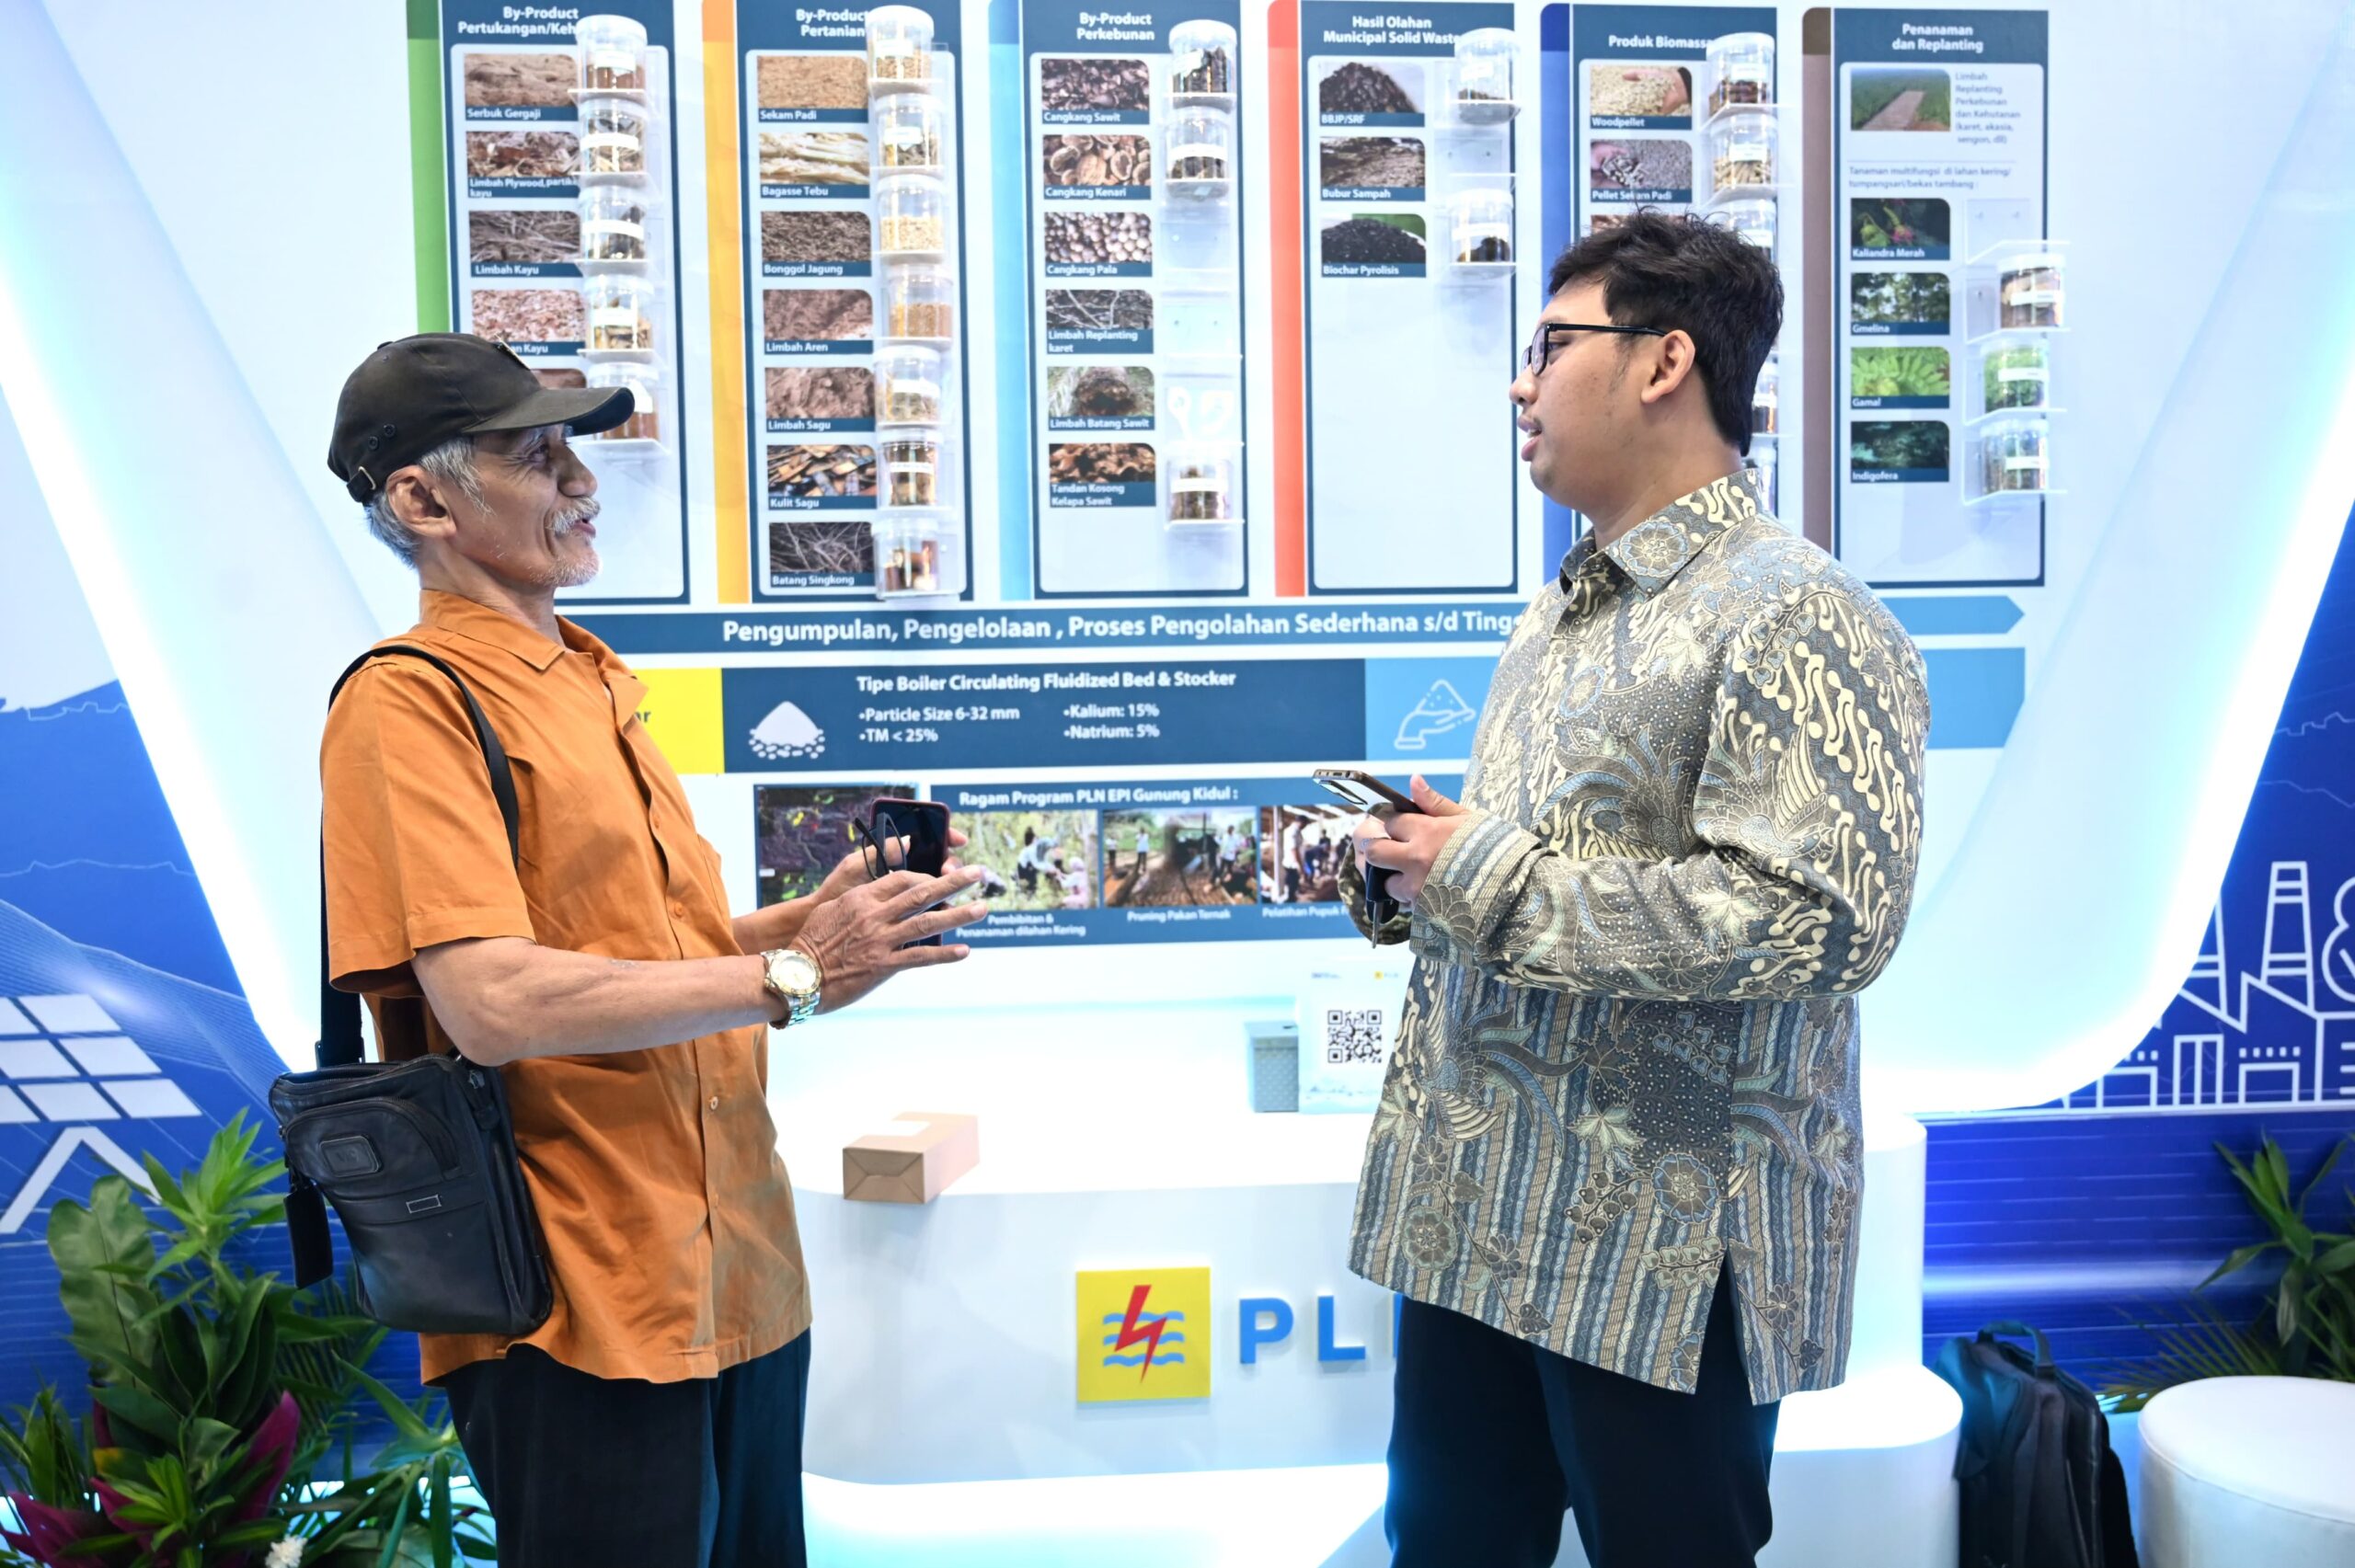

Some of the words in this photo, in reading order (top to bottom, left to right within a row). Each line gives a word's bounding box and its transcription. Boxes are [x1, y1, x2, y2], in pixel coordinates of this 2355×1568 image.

[503, 6, 579, 20] By-Product
[796, 9, 867, 23] By-Product
[1079, 12, 1152, 27] By-Product
[1352, 16, 1384, 28] Hasil
[1386, 16, 1431, 29] Olahan
[458, 21, 577, 37] Pertukangan/Keh
[801, 25, 865, 37] Pertanian
[1076, 28, 1155, 40] Perkebunan
[1902, 23, 1973, 36] Penanaman
[1324, 30, 1386, 45] Municipal
[1389, 31, 1421, 43] Solid
[1609, 36, 1653, 47] Produk
[1892, 38, 1915, 50] dan
[1918, 39, 1983, 53] Replanting
[1955, 72, 1987, 81] Limbah
[1956, 85, 2003, 95] Replanting
[1956, 97, 2007, 106] Perkebunan
[467, 109, 502, 119] Serbuk
[505, 109, 541, 120] Gergaji
[760, 109, 793, 120] Sekam
[795, 109, 817, 120] Padi
[1043, 112, 1093, 124] Cangkang
[1094, 112, 1120, 122] Sawit
[1321, 114, 1365, 124] BBJP/SRF
[1592, 118, 1645, 129] Woodpellet
[470, 178, 503, 188] Limbah
[470, 189, 492, 198] kayu
[762, 187, 802, 198] Bagasse
[803, 186, 828, 196] Tebu
[1045, 188, 1094, 199] Cangkang
[1096, 187, 1126, 197] Kenari
[1322, 189, 1351, 199] Bubur
[1352, 189, 1391, 200] Sampah
[1592, 191, 1617, 200] Pellet
[1652, 191, 1671, 200] Padi
[1853, 248, 1894, 258] Kaliandra
[1897, 248, 1924, 258] Merah
[476, 265, 512, 275] Limbah
[514, 265, 539, 276] Kayu
[764, 264, 806, 276] Bonggol
[808, 264, 843, 276] Jagung
[1047, 265, 1096, 276] Cangkang
[1097, 265, 1118, 274] Pala
[1323, 266, 1359, 275] Biochar
[1361, 266, 1399, 276] Pyrolisis
[1853, 325, 1890, 334] Gmelina
[1049, 331, 1084, 340] Limbah
[1086, 331, 1138, 342] Replanting
[523, 344, 548, 355] Kayu
[766, 342, 802, 351] Limbah
[804, 343, 828, 351] Aren
[1049, 344, 1074, 352] karet
[1853, 398, 1881, 407] Gamal
[768, 420, 805, 429] Limbah
[807, 420, 831, 432] Sagu
[1051, 419, 1086, 429] Limbah
[1087, 419, 1121, 430] Batang
[1123, 419, 1149, 429] Sawit
[1853, 472, 1898, 482] Indigofera
[1051, 484, 1086, 494] Tandan
[1089, 484, 1124, 495] Kosong
[771, 498, 793, 508] Kulit
[795, 498, 820, 509] Sagu
[1051, 497, 1084, 508] Kelapa
[1086, 497, 1112, 506] Sawit
[772, 576, 807, 587] Batang
[809, 575, 855, 586] Singkong
[723, 618, 898, 646] Pengumpulan,
[904, 616, 1051, 644] Pengelolaan
[1069, 615, 1145, 636] Proses
[1151, 613, 1288, 640] Pengolahan
[1295, 612, 1419, 634] Sederhana
[1424, 612, 1457, 633] s/d
[857, 676, 892, 694] Tipe
[897, 675, 947, 692] Boiler
[949, 673, 1040, 692] Circulating
[1044, 672, 1120, 689] Fluidized
[1122, 671, 1155, 687] Bed
[1157, 672, 1171, 687] &
[1174, 671, 1236, 687] Stocker
[924, 707, 952, 721] Size
[955, 706, 988, 720] 6-32
[992, 708, 1020, 720] mm
[1129, 704, 1159, 717] 15%
[893, 732, 902, 741] <
[906, 729, 938, 742] 25%
[1136, 725, 1160, 738] 5%
[959, 793, 1010, 807] Ragam
[1013, 791, 1074, 807] Program
[1077, 788, 1104, 802] PLN
[1108, 788, 1132, 801] EPI
[1133, 787, 1190, 803] Gunung
[1193, 786, 1230, 800] Kidul
[1127, 911, 1166, 922] Pruning
[1167, 910, 1197, 921] Pakan
[1198, 910, 1230, 920] Ternak
[1262, 907, 1306, 917] Pelatihan
[1308, 906, 1339, 917] Pupuk
[988, 914, 1044, 925] Pembibitan
[956, 927, 1014, 937] Penanaman
[1053, 925, 1086, 937] Kering
[1240, 1293, 1402, 1364] PL
